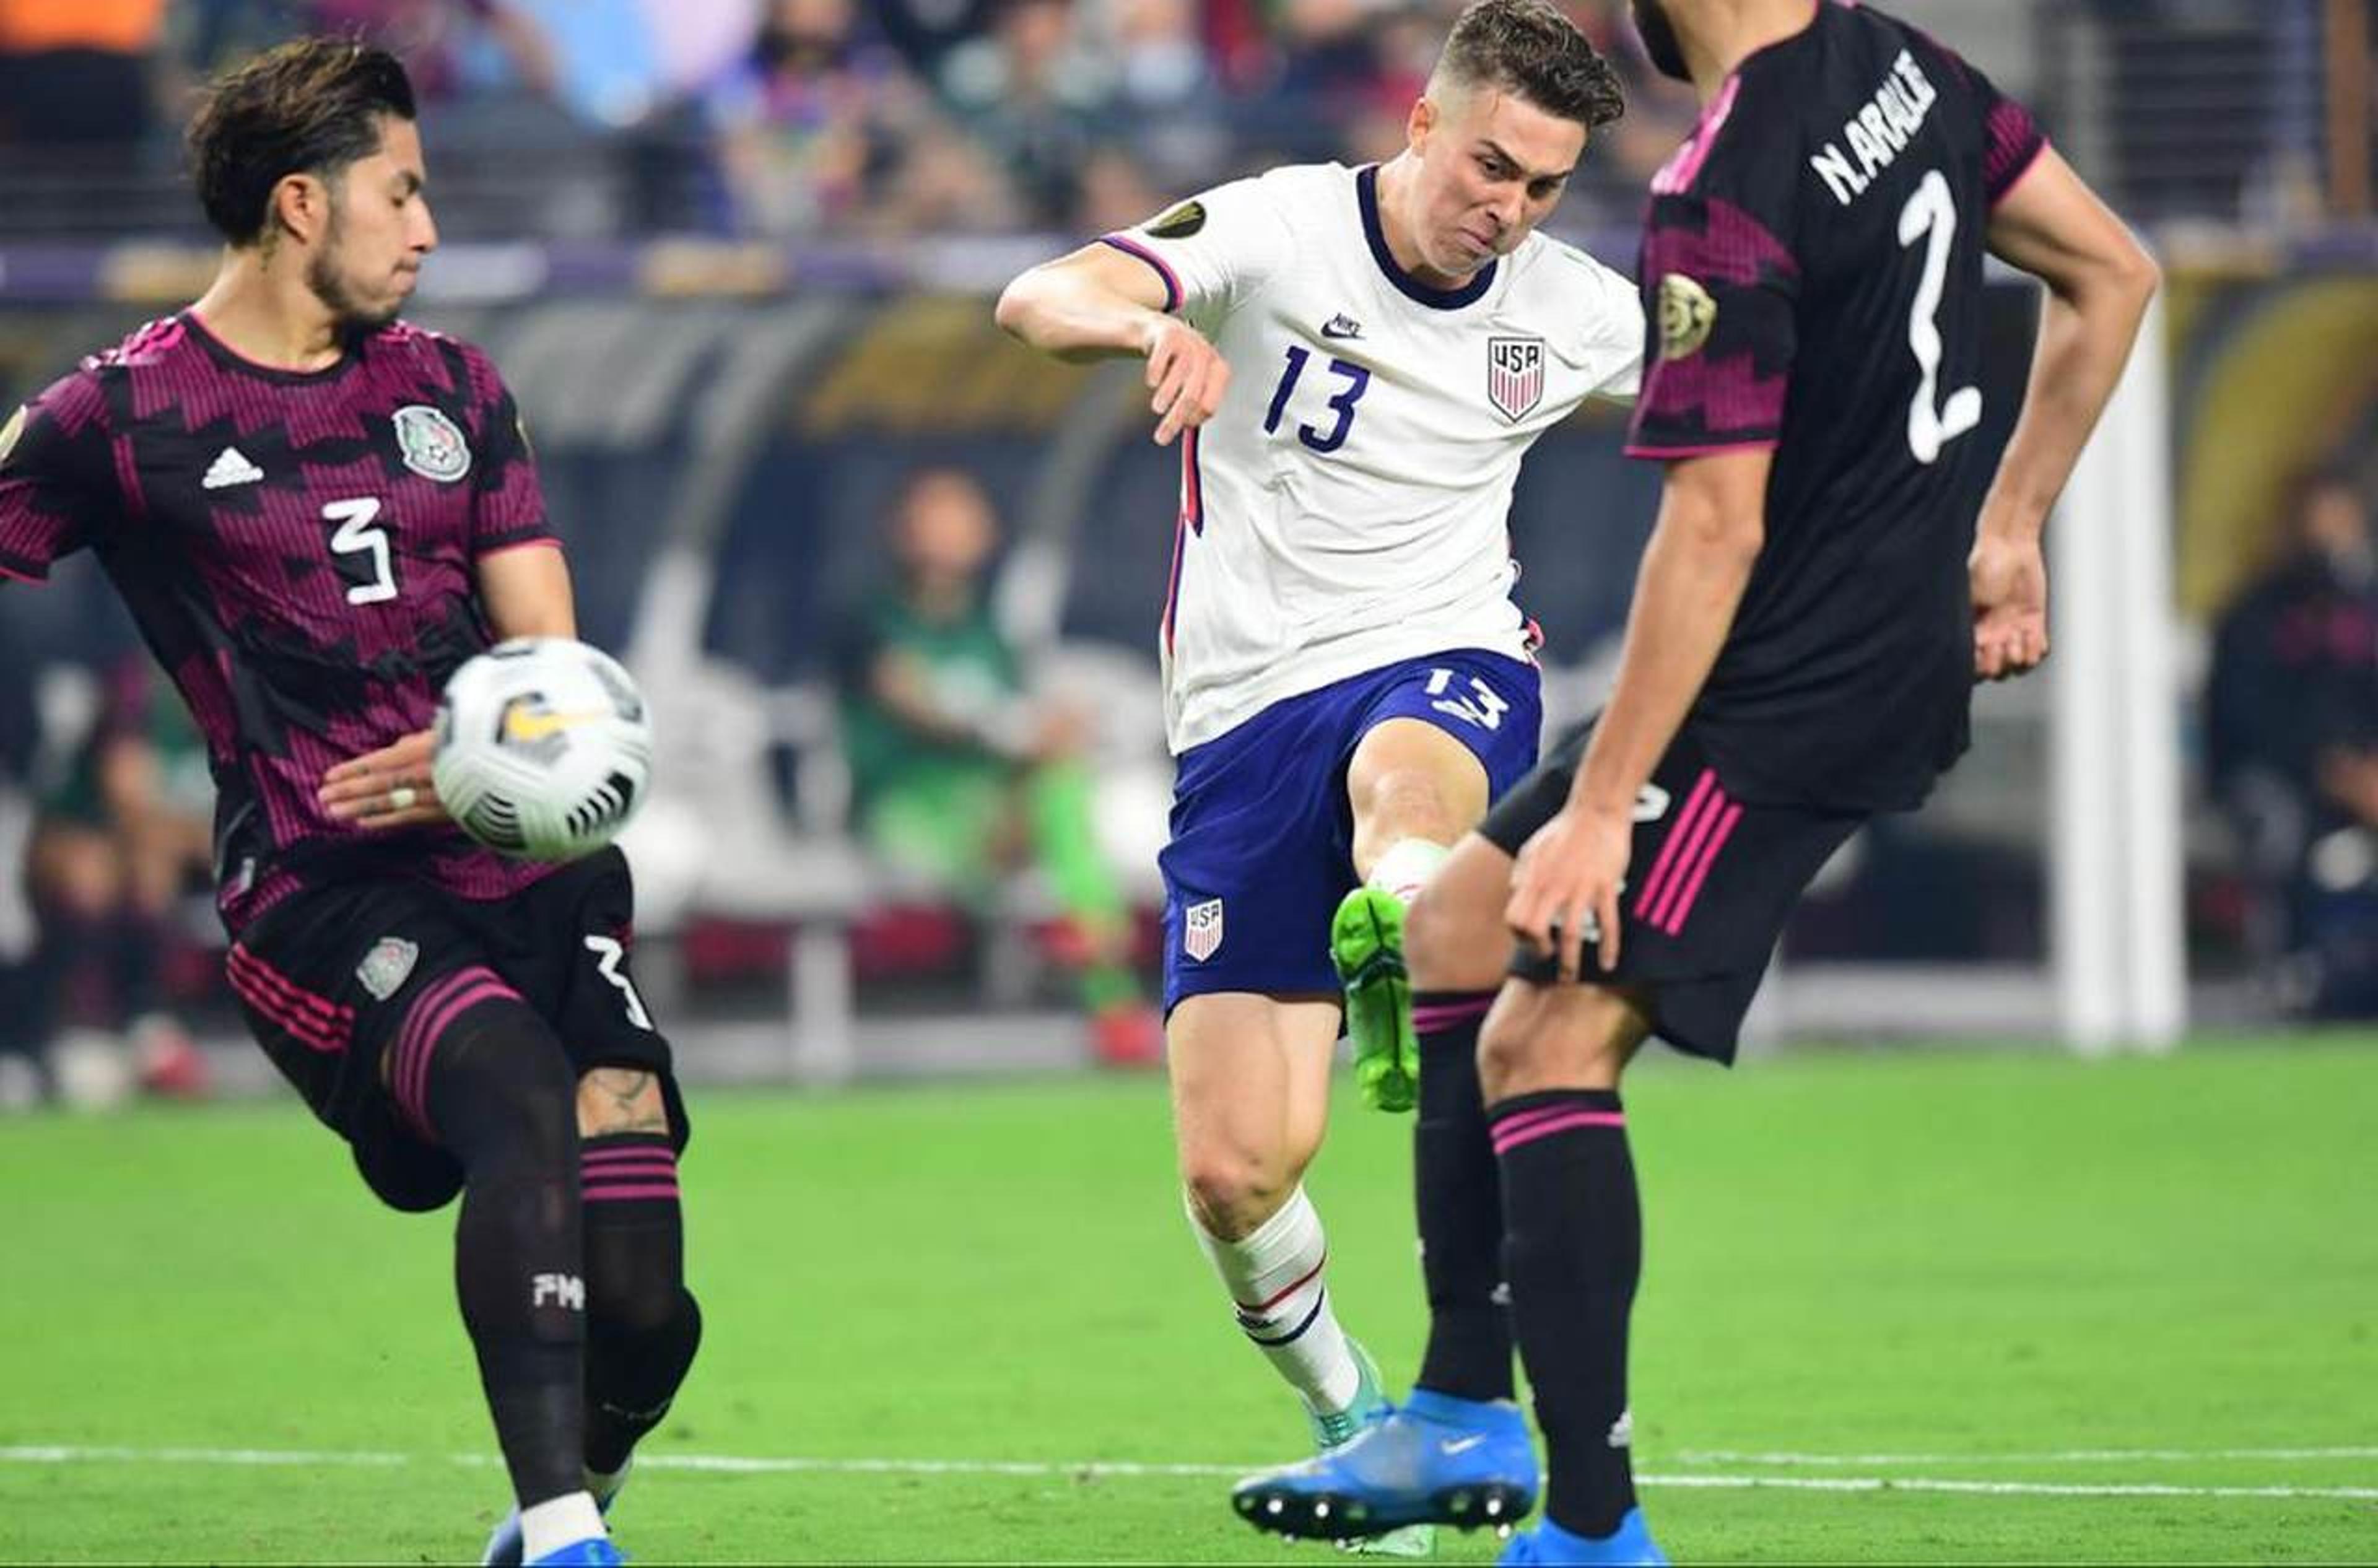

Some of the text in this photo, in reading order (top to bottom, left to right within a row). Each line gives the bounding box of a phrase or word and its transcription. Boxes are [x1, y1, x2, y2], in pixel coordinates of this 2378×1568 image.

[1494, 344, 1539, 373] USA
[1897, 169, 1982, 464] 2
[1264, 345, 1371, 453] 13
[322, 497, 398, 605] 3
[1426, 668, 1509, 730] 13
[1190, 903, 1219, 928] USA
[584, 934, 653, 1030] 3
